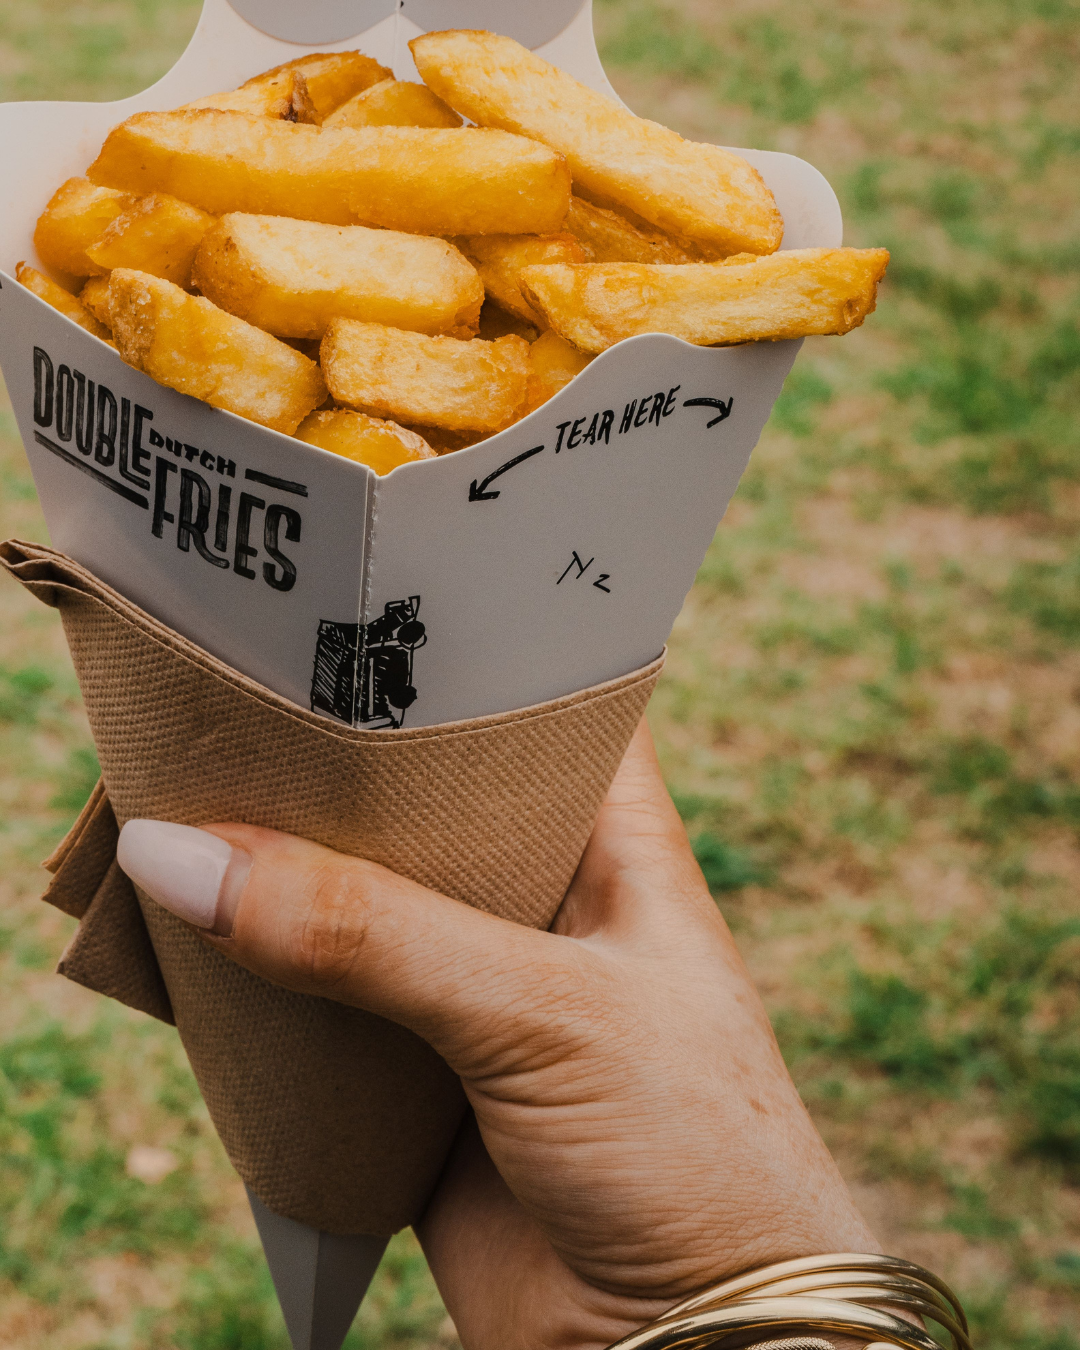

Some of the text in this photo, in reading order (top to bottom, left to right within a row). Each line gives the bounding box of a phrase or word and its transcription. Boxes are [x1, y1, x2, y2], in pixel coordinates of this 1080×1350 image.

[33, 345, 154, 492] DOUBLE
[149, 427, 237, 478] DUTCH
[554, 384, 681, 454] TEAR HERE
[151, 455, 302, 592] FRIES
